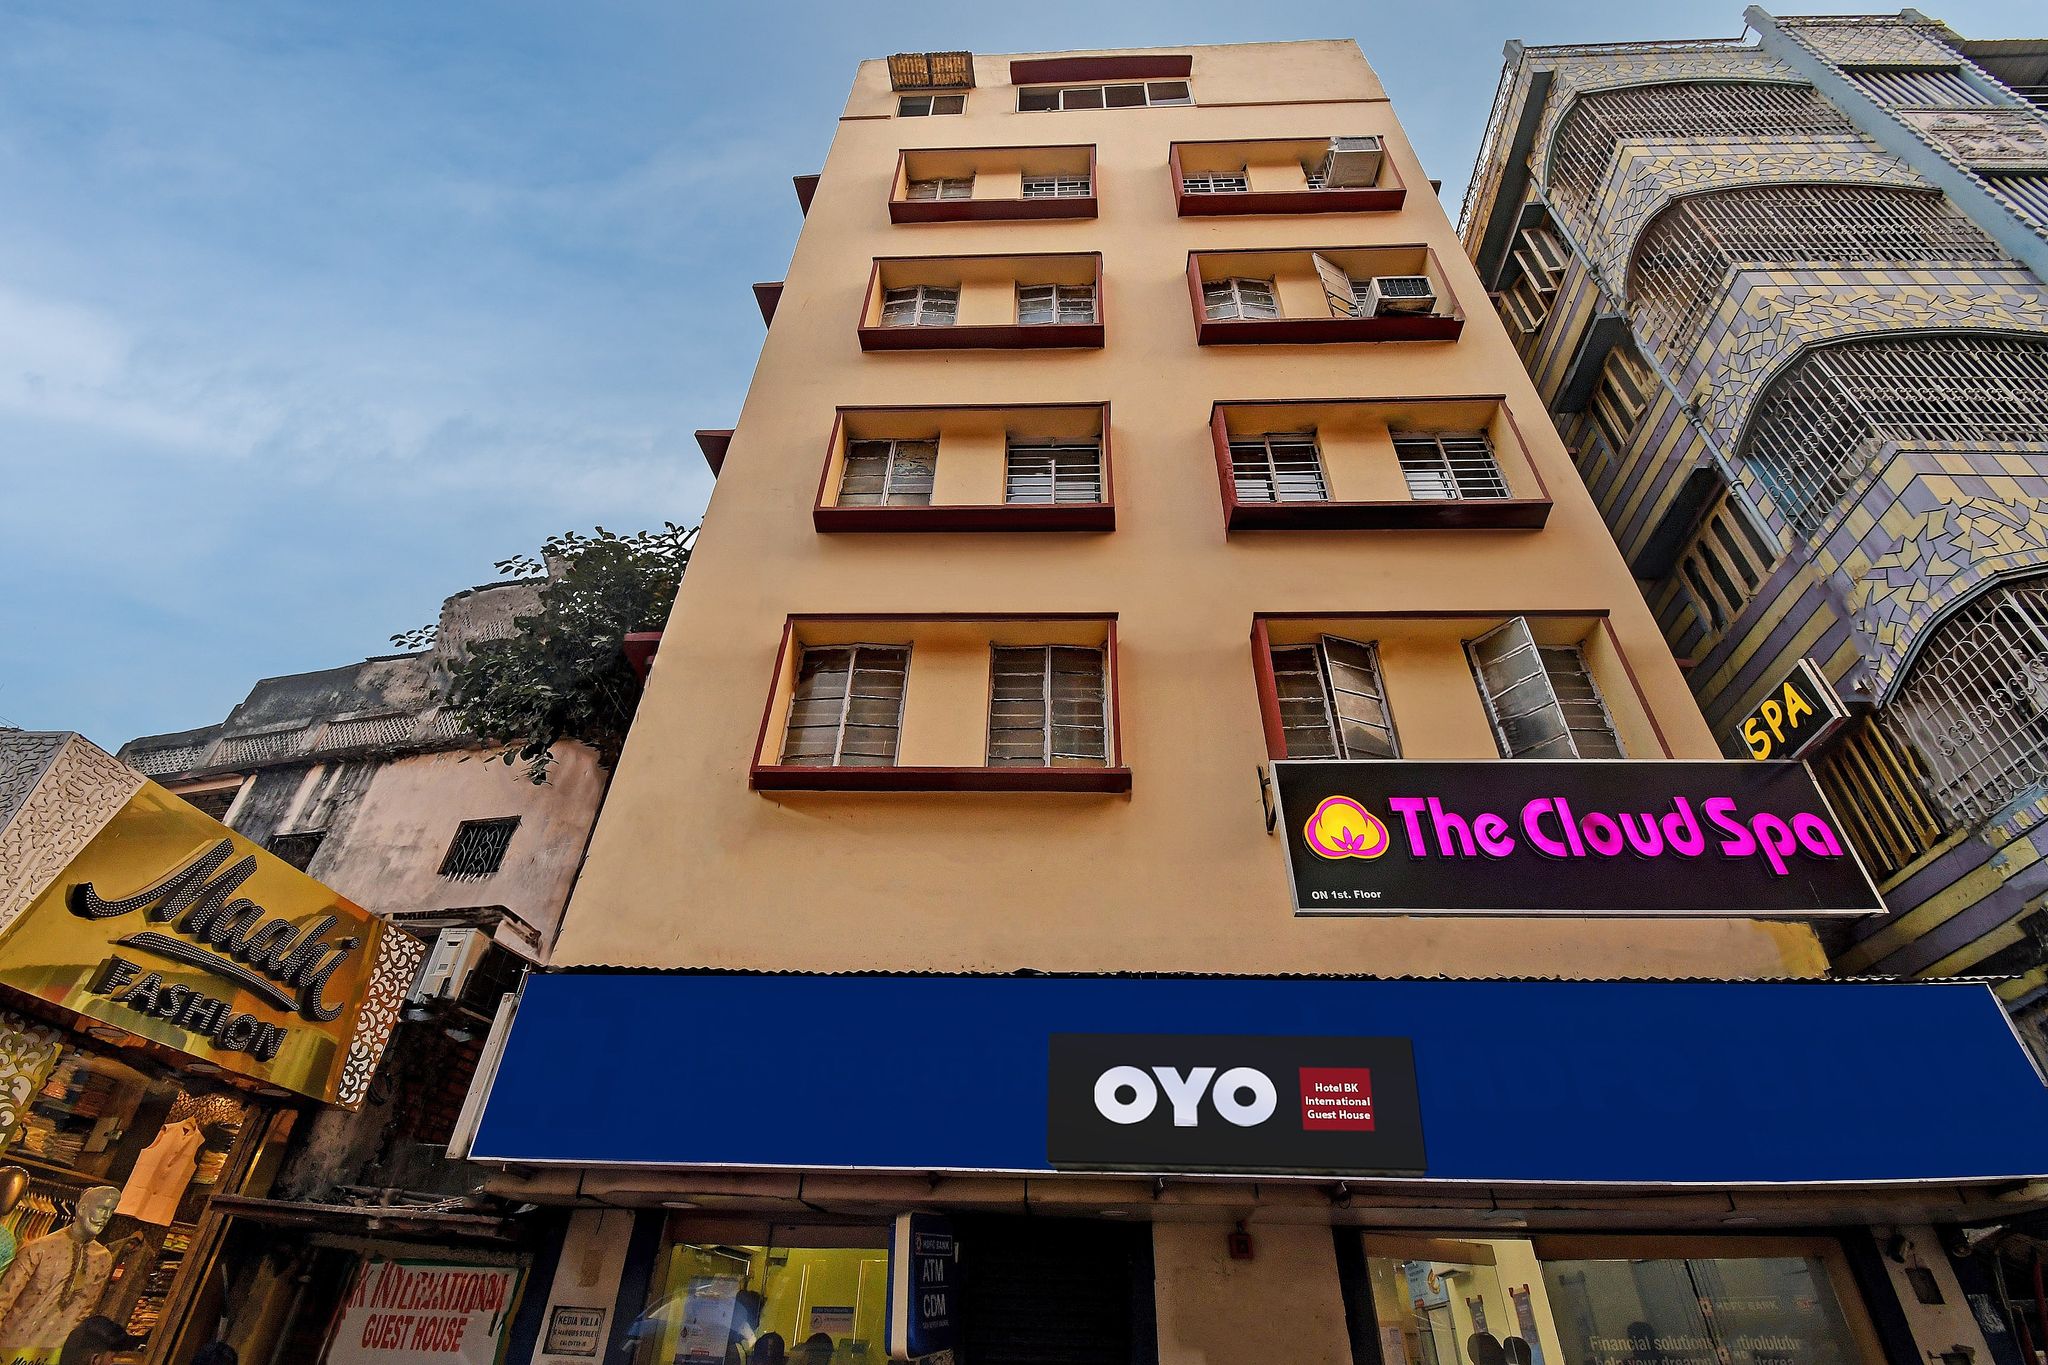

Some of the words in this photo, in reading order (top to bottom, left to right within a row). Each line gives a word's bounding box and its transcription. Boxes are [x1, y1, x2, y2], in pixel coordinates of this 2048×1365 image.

[1743, 681, 1813, 760] SPA
[1388, 797, 1516, 859] The
[1521, 796, 1705, 859] Cloud
[1705, 796, 1844, 875] Spa
[1311, 889, 1328, 900] ON
[1331, 889, 1351, 900] 1st.
[1353, 888, 1382, 900] Floor
[92, 955, 288, 1061] FASHION
[1093, 1065, 1278, 1128] OYO
[1314, 1082, 1343, 1093] Hotel
[1344, 1083, 1359, 1093] BK
[1305, 1095, 1371, 1107] International
[1307, 1109, 1337, 1120] Guest
[1338, 1110, 1371, 1121] House
[923, 1258, 944, 1282] ATM
[923, 1293, 947, 1318] CDM
[362, 1313, 414, 1350] GUEST
[410, 1317, 467, 1352] HOUSE
[1589, 1335, 1651, 1351] Financial
